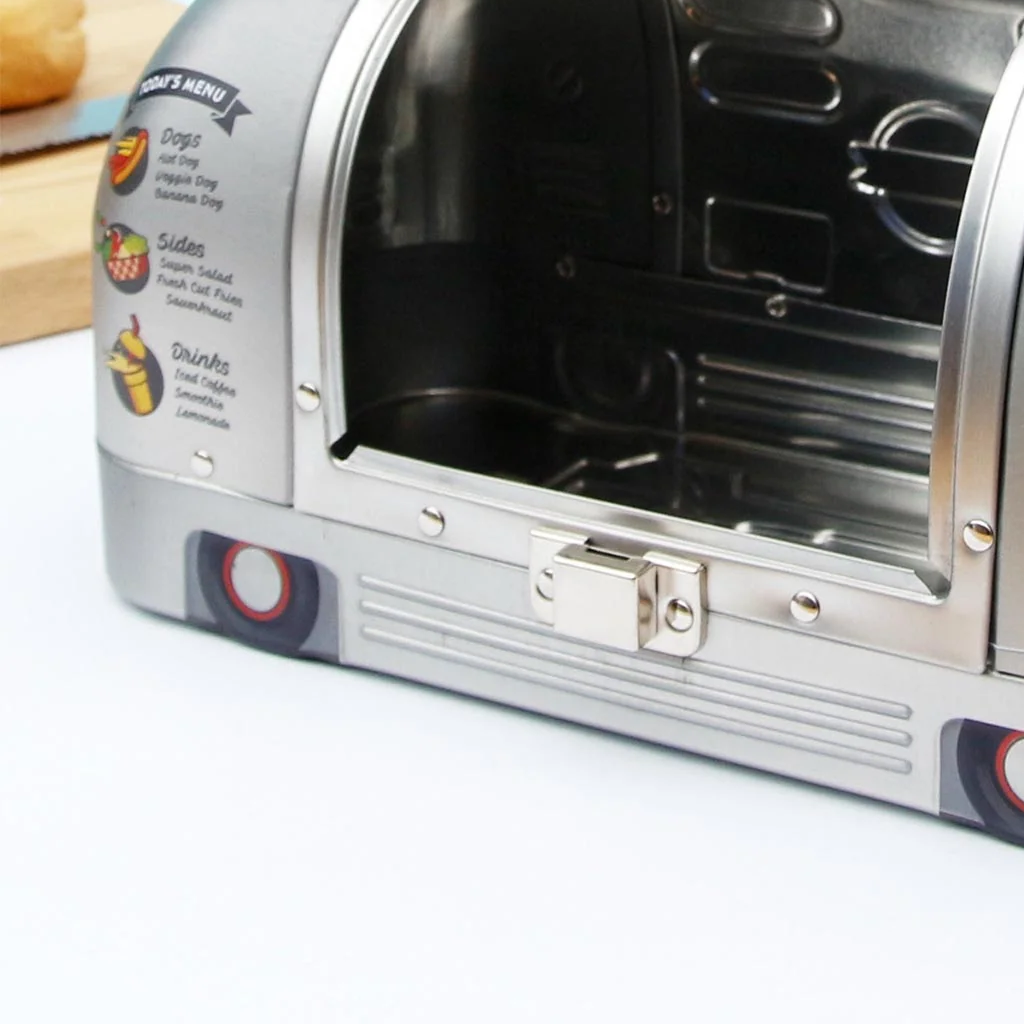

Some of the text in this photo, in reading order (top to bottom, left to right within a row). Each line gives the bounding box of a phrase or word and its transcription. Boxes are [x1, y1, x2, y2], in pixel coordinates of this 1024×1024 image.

[138, 74, 227, 103] TODAY'S MENU
[160, 127, 202, 152] Dogs
[178, 155, 200, 171] Dog
[195, 175, 219, 192] Dog
[154, 188, 224, 212] Banana Dog
[157, 232, 205, 258] Sides
[160, 257, 234, 285] Super Salad
[156, 274, 243, 308] Fresh Cut Fries
[165, 294, 233, 322] Sauerkraut
[171, 341, 230, 376] Drinks
[174, 368, 237, 398] Iced Coffee
[174, 387, 224, 410] Smoothie
[175, 406, 231, 430] Lemonade
